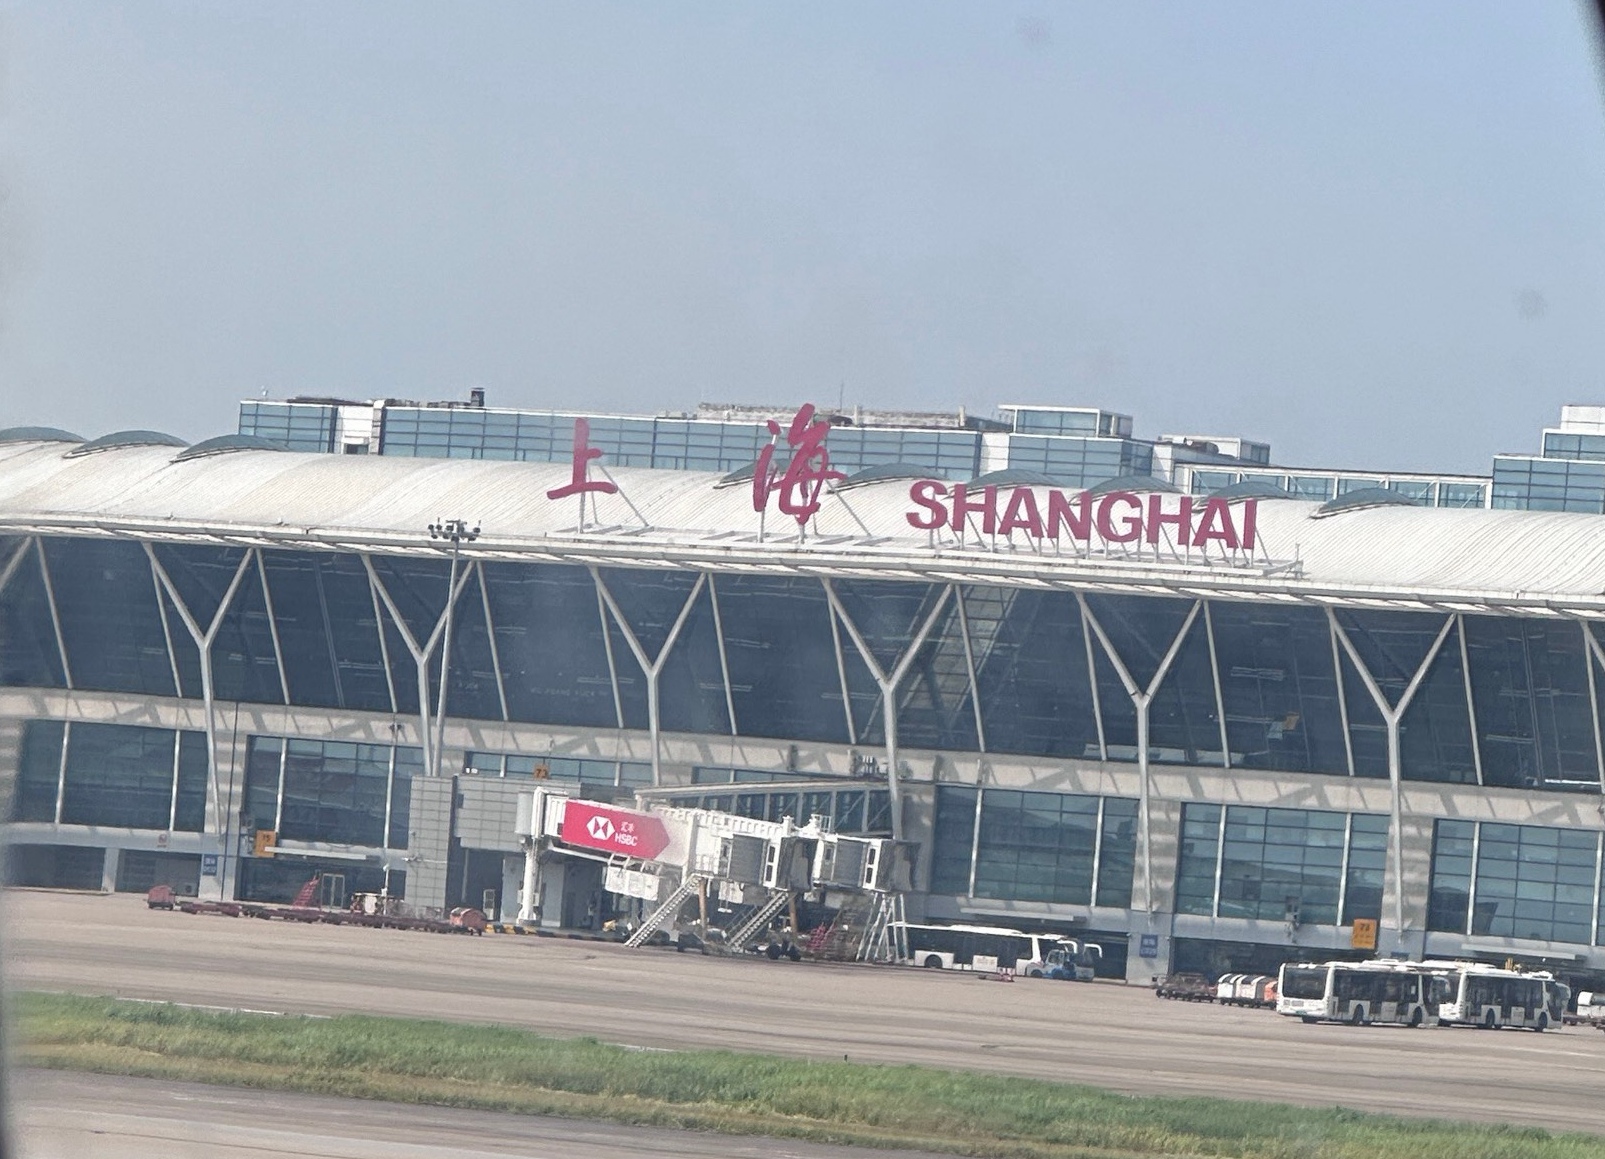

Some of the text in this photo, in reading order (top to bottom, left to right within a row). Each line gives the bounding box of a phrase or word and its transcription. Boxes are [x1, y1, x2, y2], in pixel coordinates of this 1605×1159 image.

[548, 403, 1257, 549] 上海 SHANGHAI
[615, 832, 638, 846] HSBC
